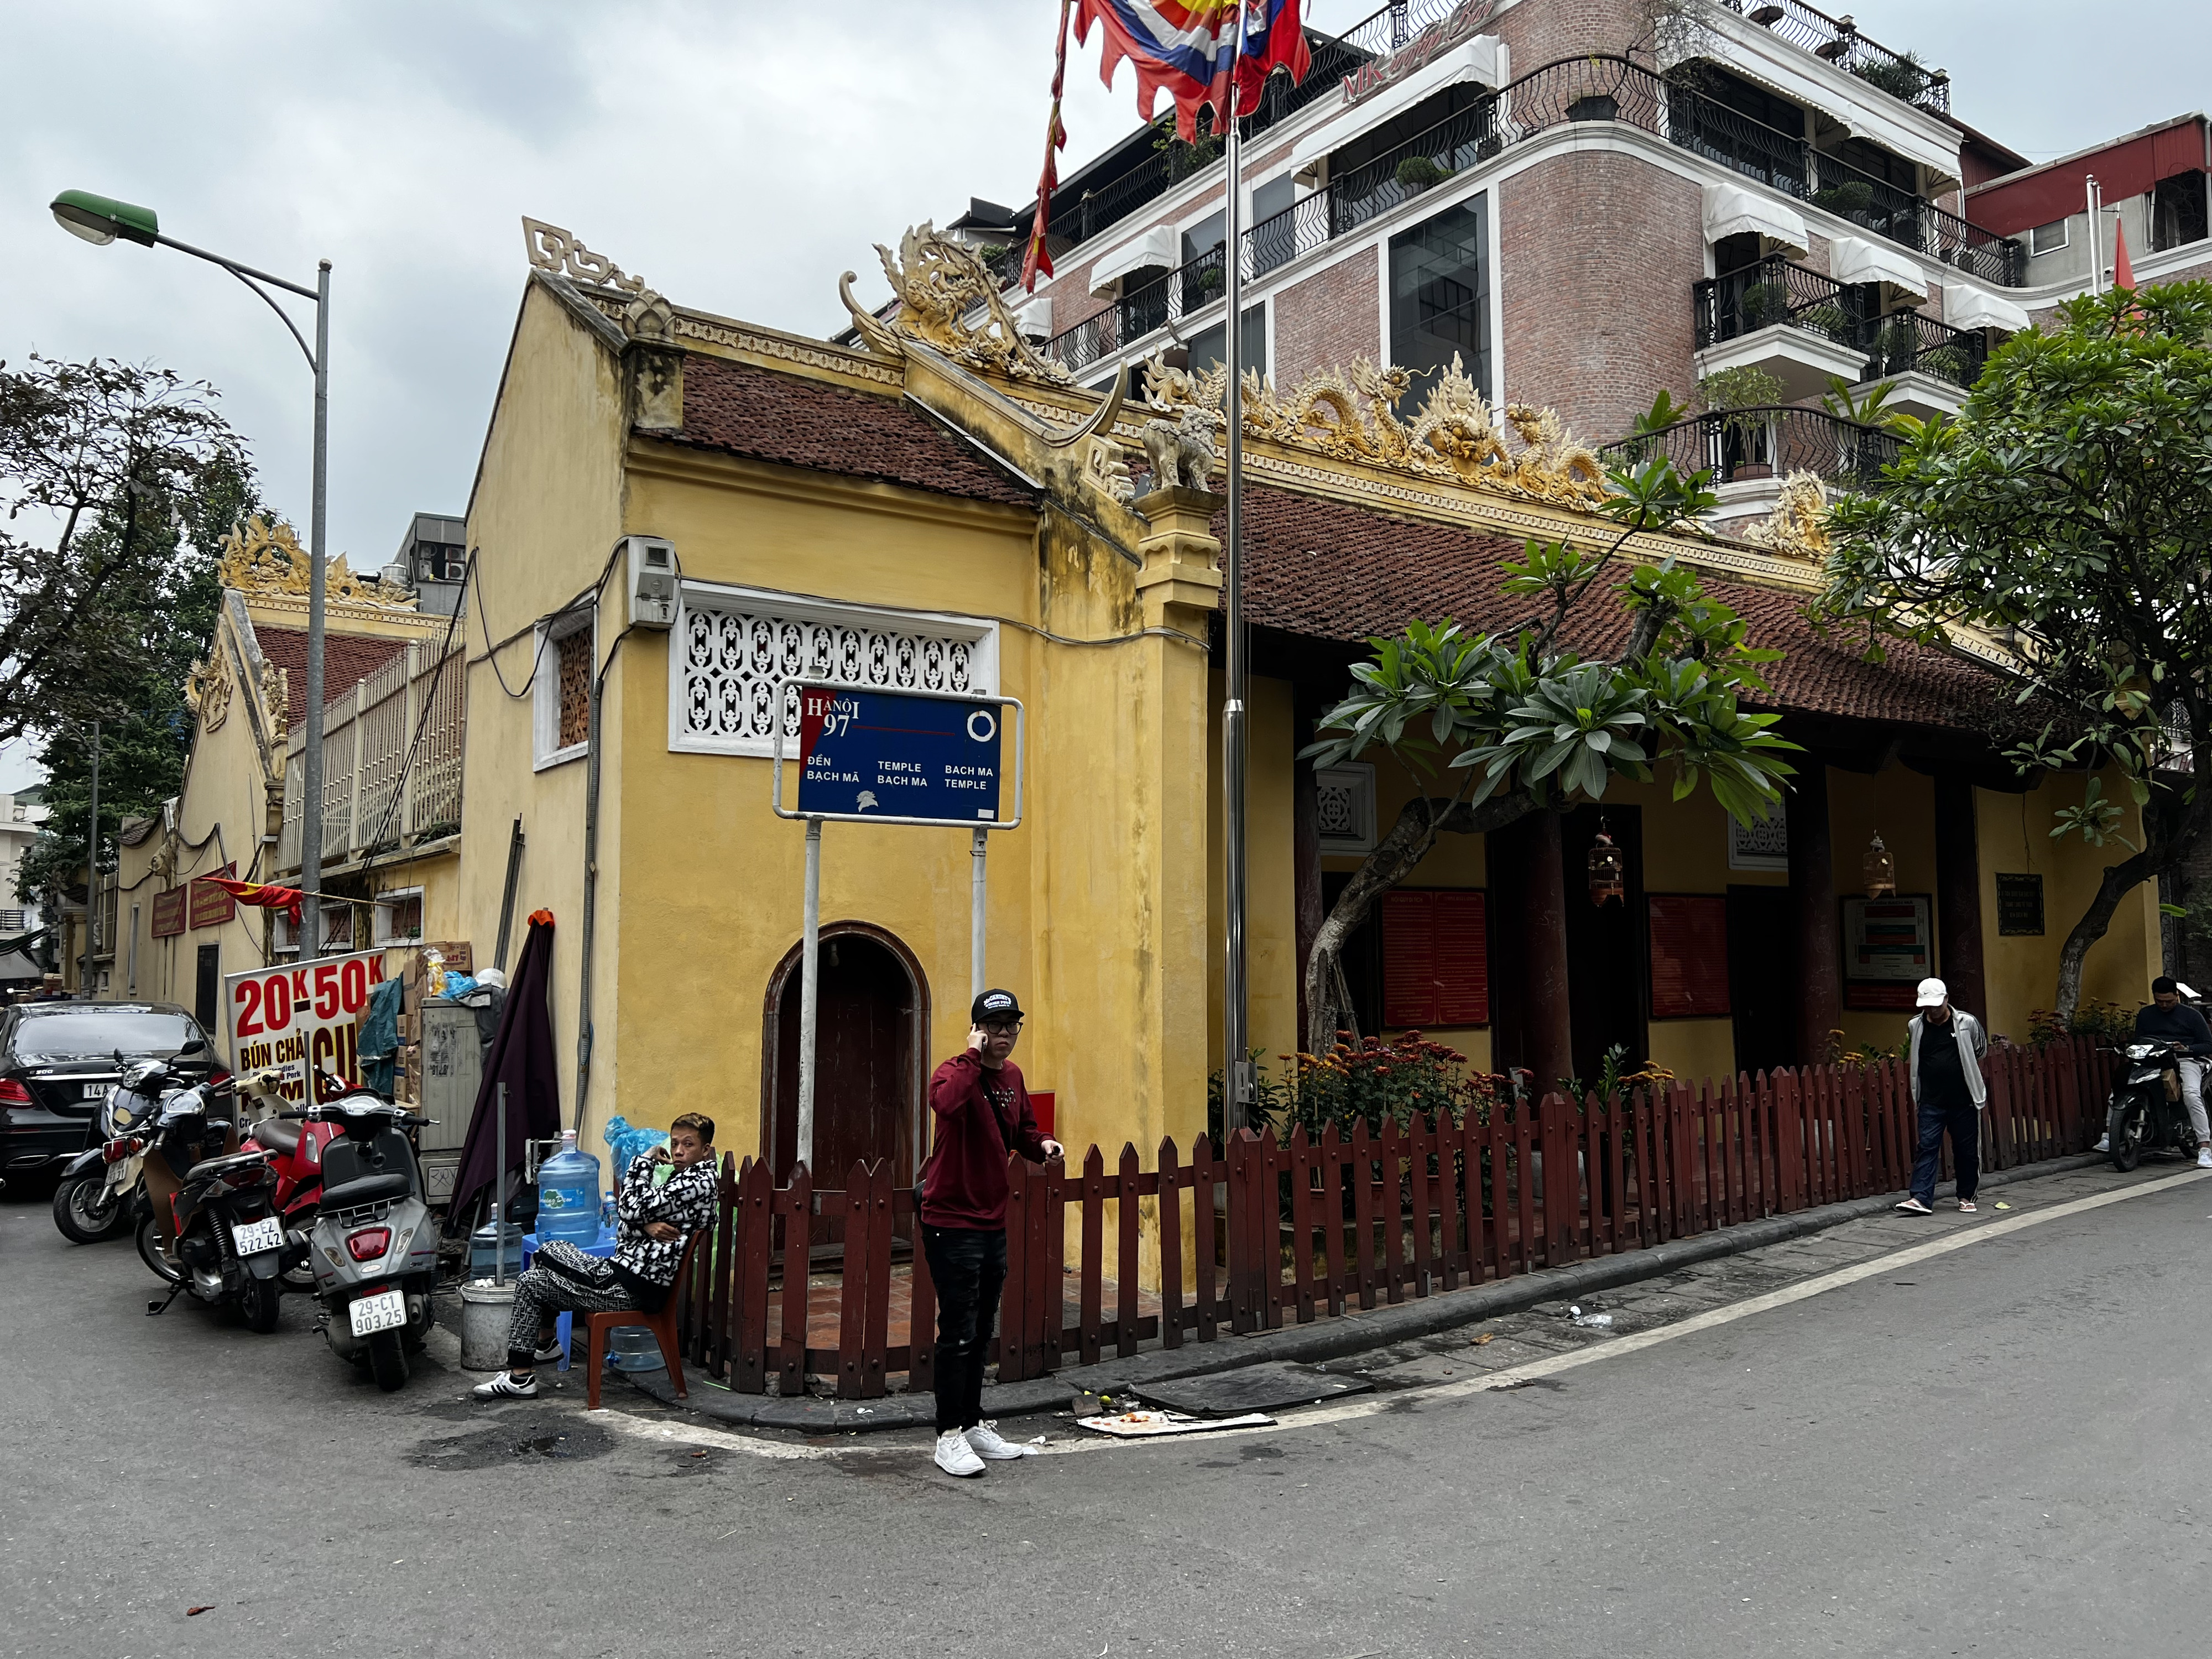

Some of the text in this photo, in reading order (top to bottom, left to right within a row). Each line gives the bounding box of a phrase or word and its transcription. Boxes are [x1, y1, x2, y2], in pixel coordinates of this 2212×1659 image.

[823, 713, 850, 737] 97
[807, 753, 831, 766] ĐỀN
[878, 760, 922, 773] TEMPLE
[945, 765, 994, 777] BACH MA
[807, 770, 860, 782] BẠCH MÃ
[877, 775, 928, 787] BACH MA
[945, 779, 987, 790] TEMPLE
[240, 1028, 305, 1072] BÚN CHẢ
[286, 1071, 301, 1079] Pork
[241, 1220, 274, 1239] 29-E2
[239, 1233, 281, 1254] 522.42
[358, 1295, 394, 1317] 29-C1
[356, 1309, 402, 1333] 903.25
